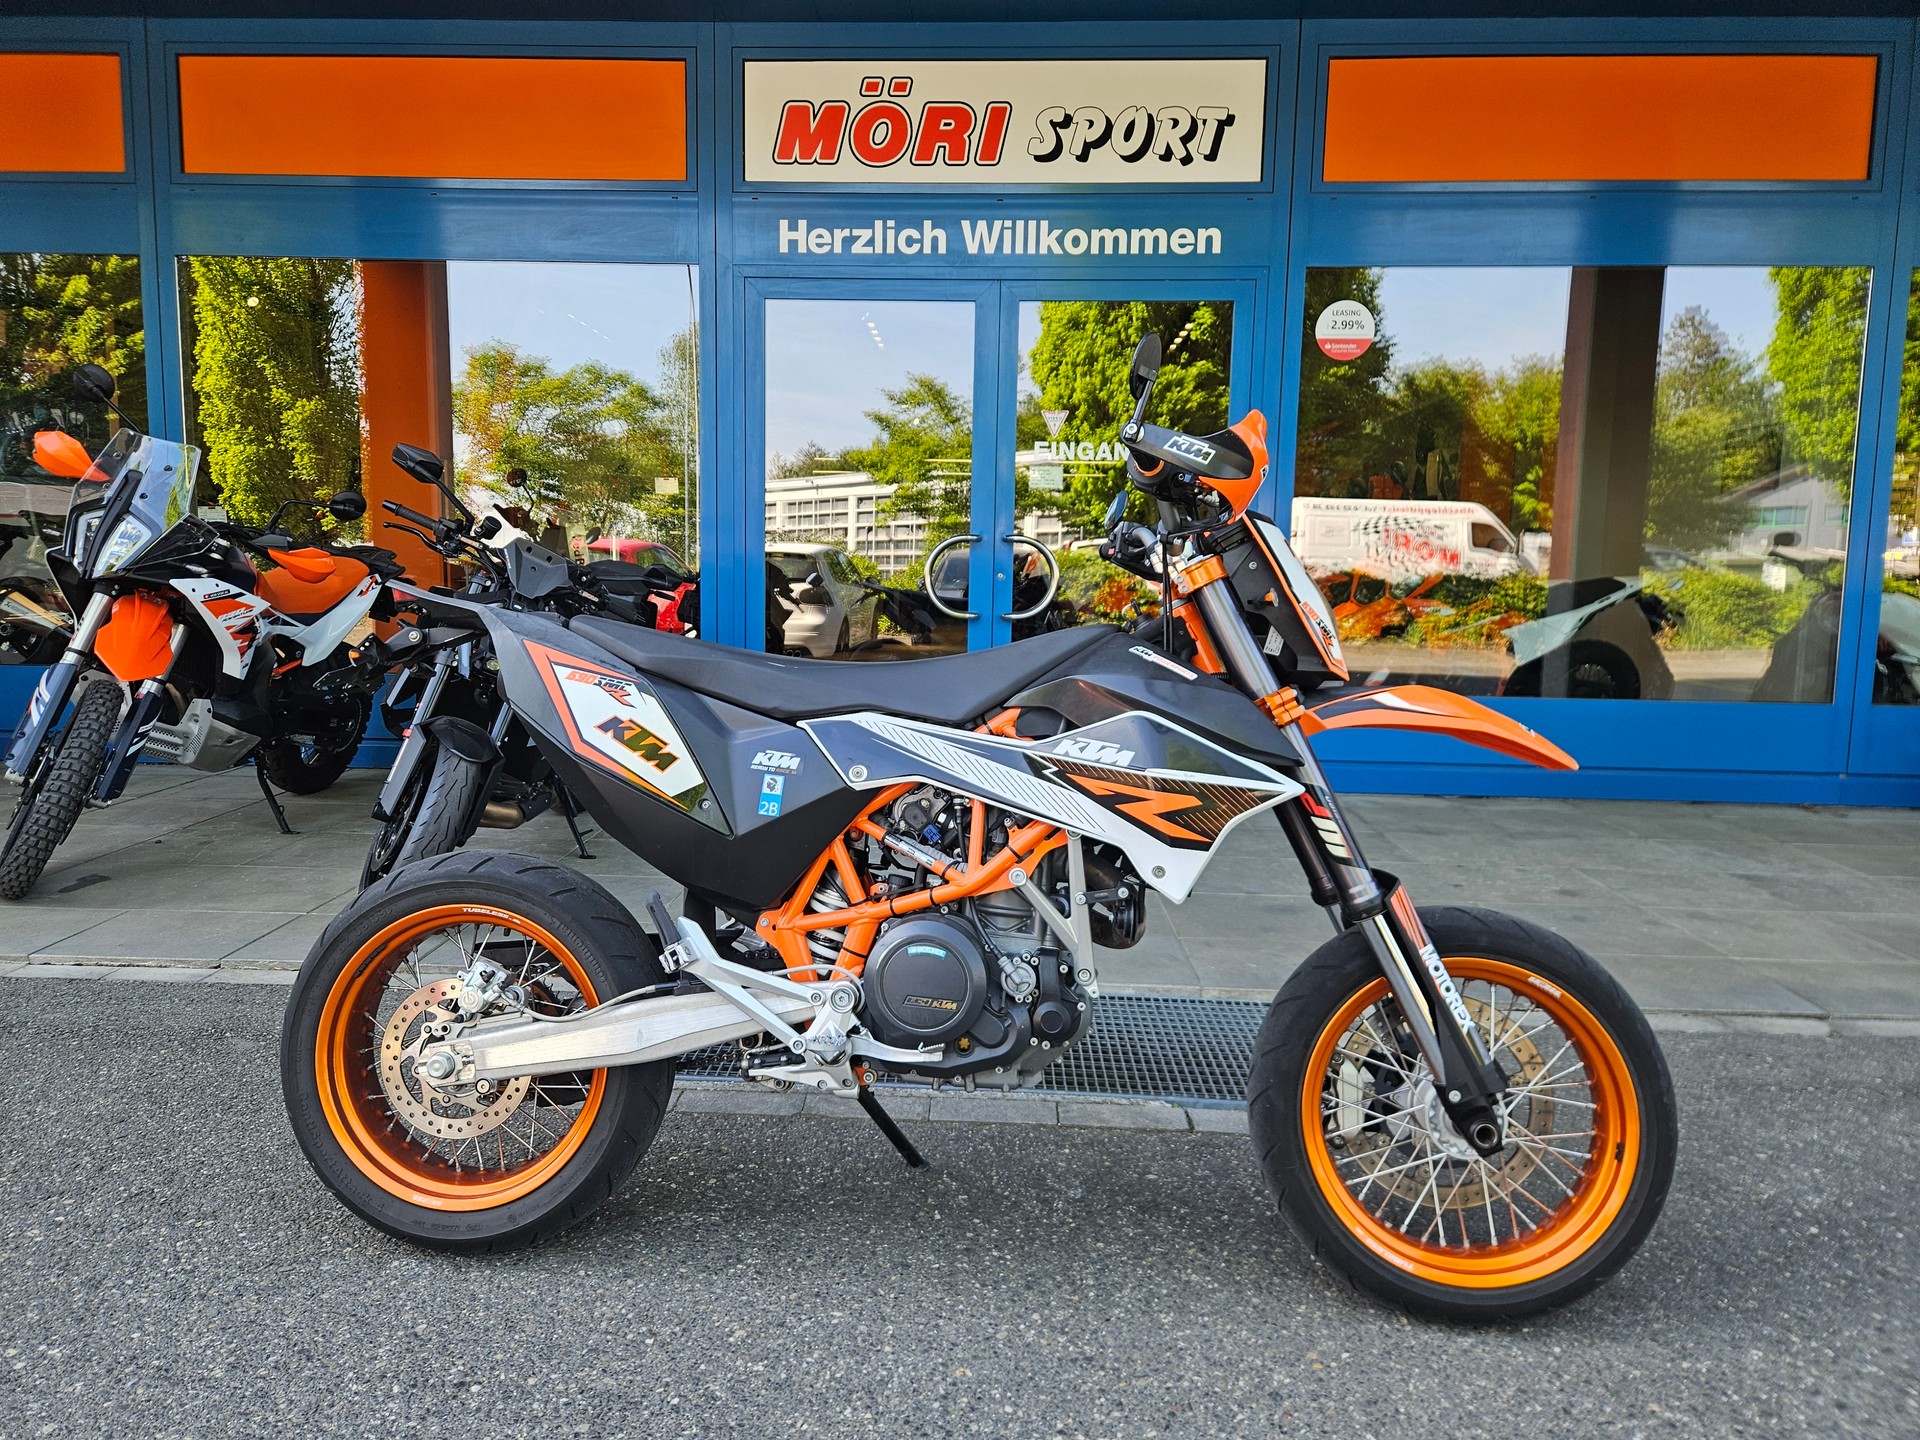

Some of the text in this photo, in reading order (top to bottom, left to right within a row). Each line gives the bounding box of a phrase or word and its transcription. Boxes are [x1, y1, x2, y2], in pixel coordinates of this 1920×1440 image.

[773, 76, 1235, 169] MÖRI SPORT
[779, 219, 1222, 255] Herzlich Willkommen
[1332, 309, 1361, 317] LEASING
[1331, 320, 1365, 330] 2.99%
[1034, 440, 1130, 461] EINGAN
[1163, 435, 1216, 465] KTM
[565, 670, 599, 685] 690
[594, 714, 680, 773] KTM
[1052, 737, 1136, 767] KTM
[752, 750, 801, 769] KTM
[760, 801, 779, 816] 2B
[462, 907, 509, 919] TUBELESS
[1420, 944, 1476, 1034] MOTOREX
[931, 1000, 958, 1010] KTM
